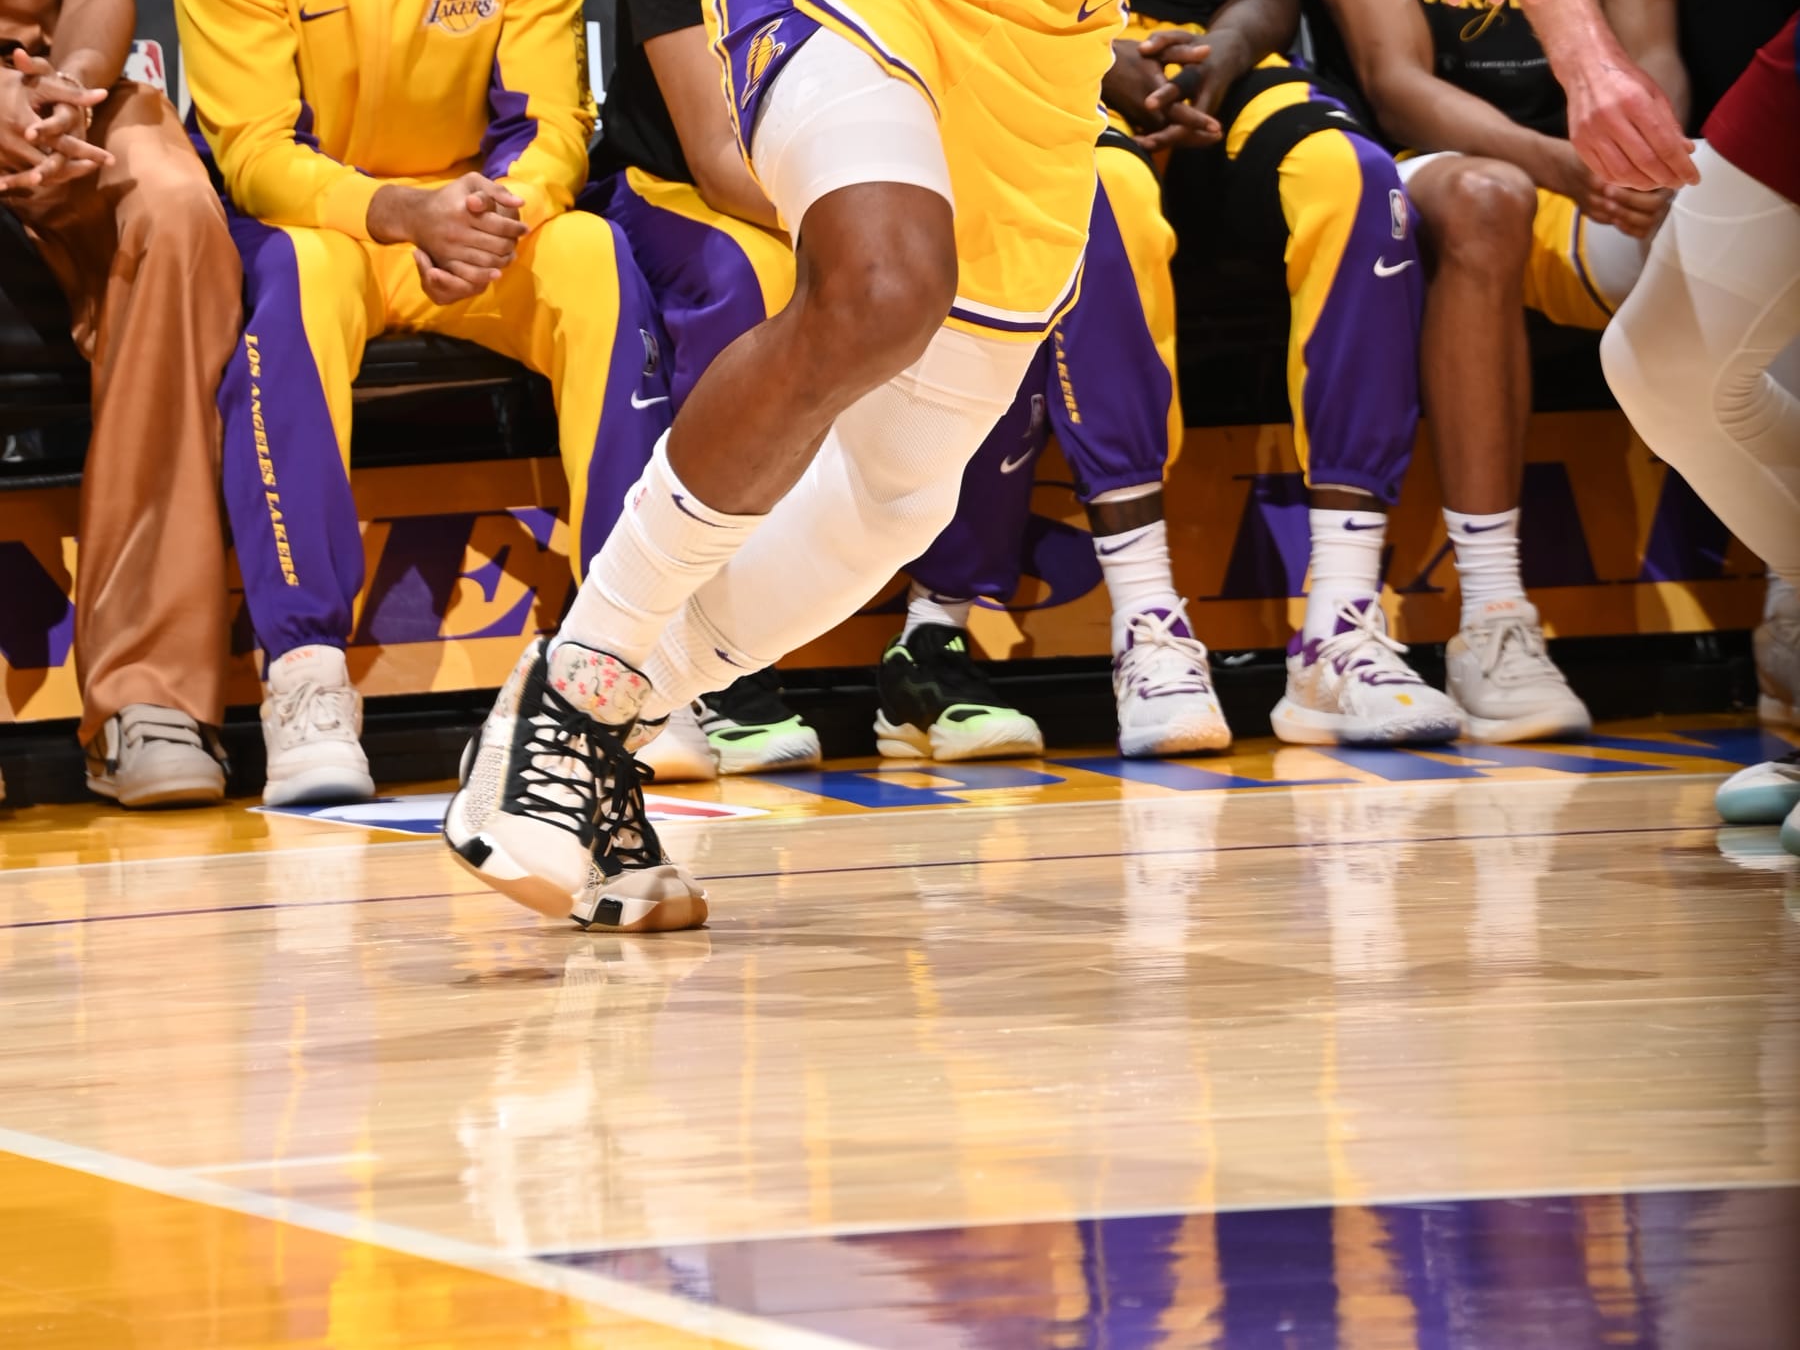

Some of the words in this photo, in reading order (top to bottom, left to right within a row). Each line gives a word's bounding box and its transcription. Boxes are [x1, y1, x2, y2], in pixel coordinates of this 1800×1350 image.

[244, 332, 262, 378] LOS
[250, 382, 278, 487] ANGELES
[265, 490, 300, 588] LAKERS
